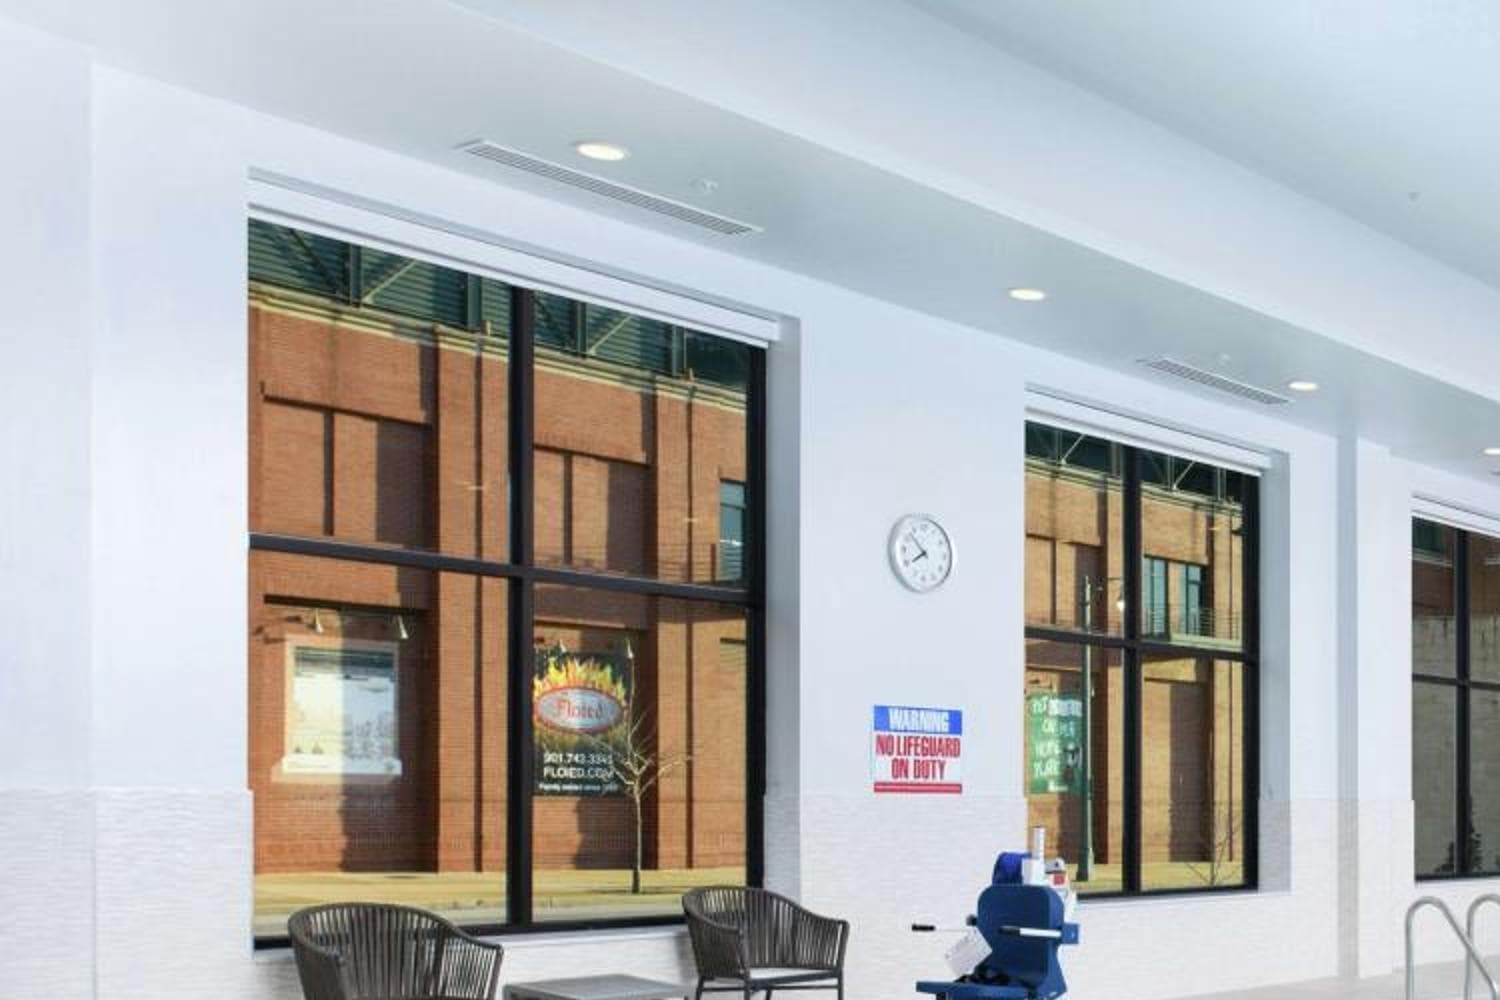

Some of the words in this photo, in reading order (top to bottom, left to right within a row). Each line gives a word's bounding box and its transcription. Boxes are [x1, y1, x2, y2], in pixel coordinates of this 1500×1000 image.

[889, 708, 949, 733] WARNING
[876, 735, 894, 756] NO
[897, 736, 960, 758] LIFEGUARD
[892, 758, 908, 779] ON
[914, 760, 946, 779] DUTY
